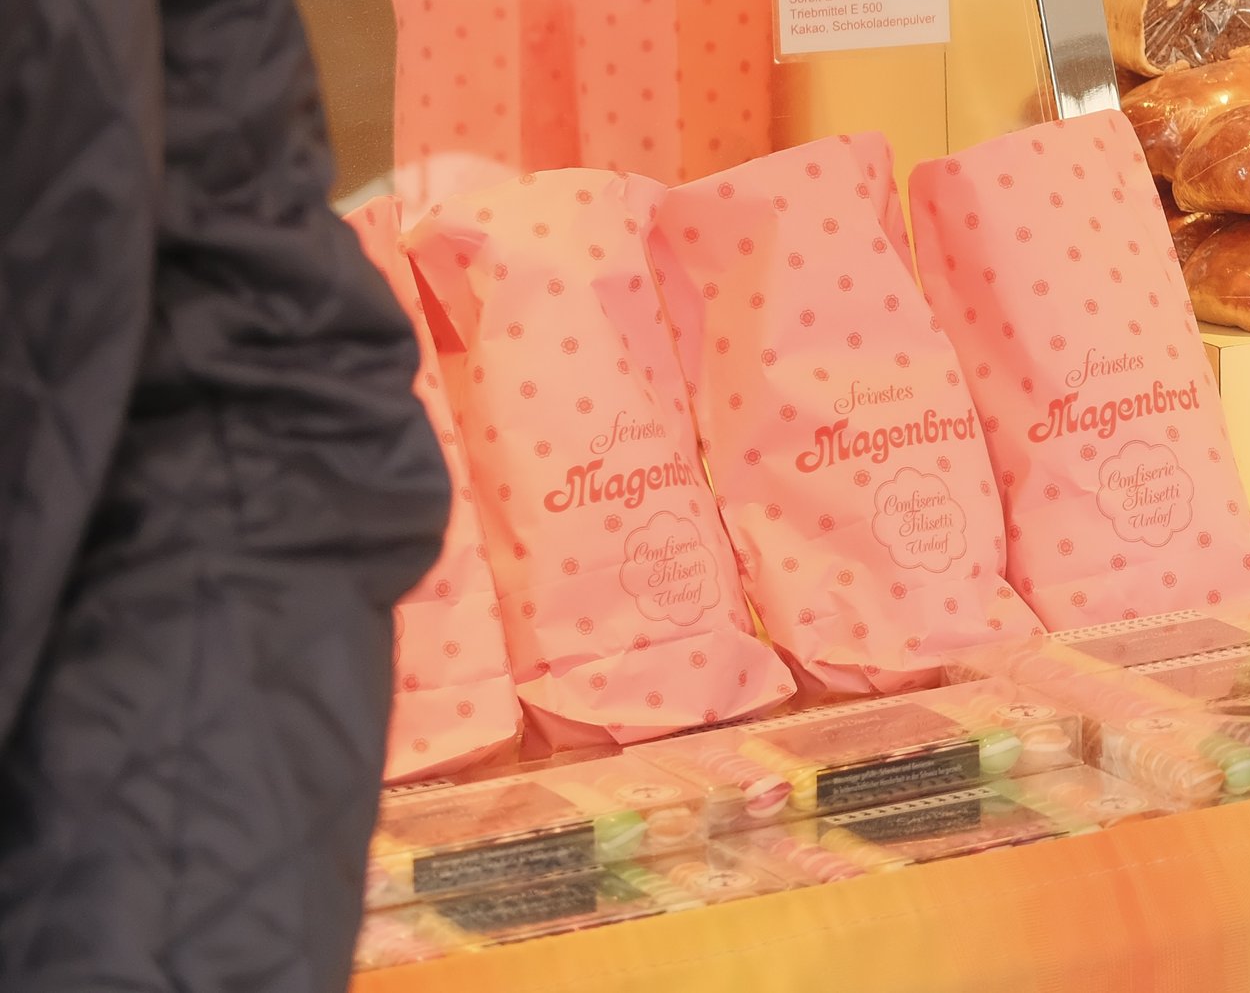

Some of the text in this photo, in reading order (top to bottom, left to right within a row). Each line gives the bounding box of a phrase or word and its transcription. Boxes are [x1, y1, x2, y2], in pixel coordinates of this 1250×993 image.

[790, 2, 883, 20] Triebmittel E 500
[832, 14, 936, 32] Schokoladenpulver
[1065, 348, 1144, 388] feinstes
[833, 380, 914, 415] feinstes
[1027, 379, 1200, 443] Magenbrot
[795, 408, 976, 473] Magenbrot
[1107, 462, 1175, 491] Confiserie
[883, 491, 946, 516] Confiserie
[1122, 484, 1180, 511] Filisetti
[899, 508, 952, 537] Filisetti
[1128, 503, 1176, 528] Urdorf
[633, 536, 698, 564] Confiserie
[906, 532, 951, 555] Urdorf
[648, 558, 706, 588] Filisetti
[653, 582, 702, 607] Urdorf
